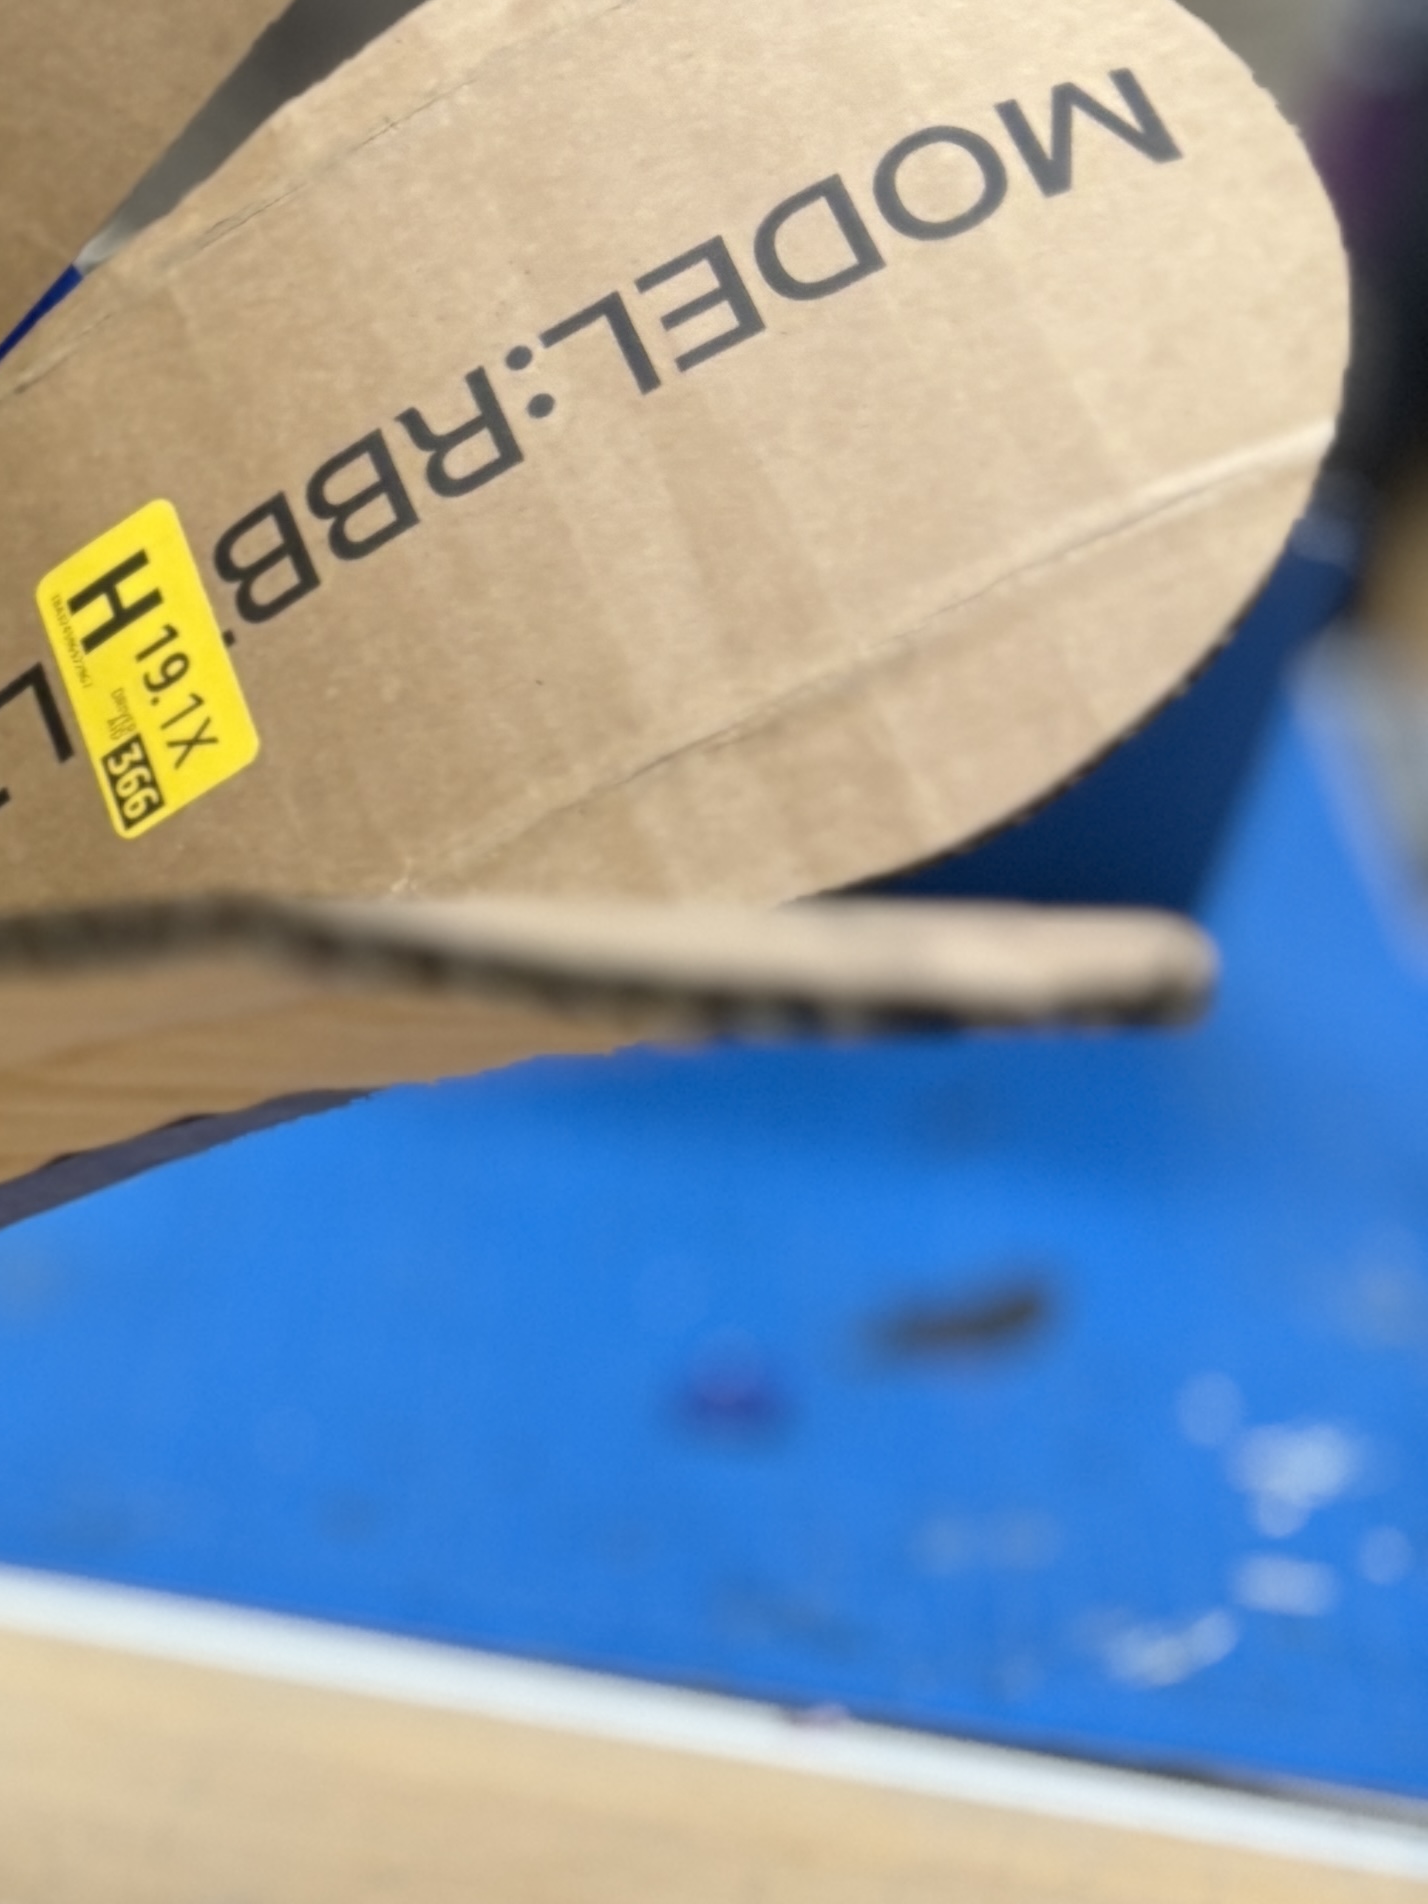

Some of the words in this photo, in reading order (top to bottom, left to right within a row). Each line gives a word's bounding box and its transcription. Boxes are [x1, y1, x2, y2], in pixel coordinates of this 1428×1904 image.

[67, 548, 164, 655] H
[135, 624, 219, 771] 19.1X
[107, 742, 160, 820] 366
